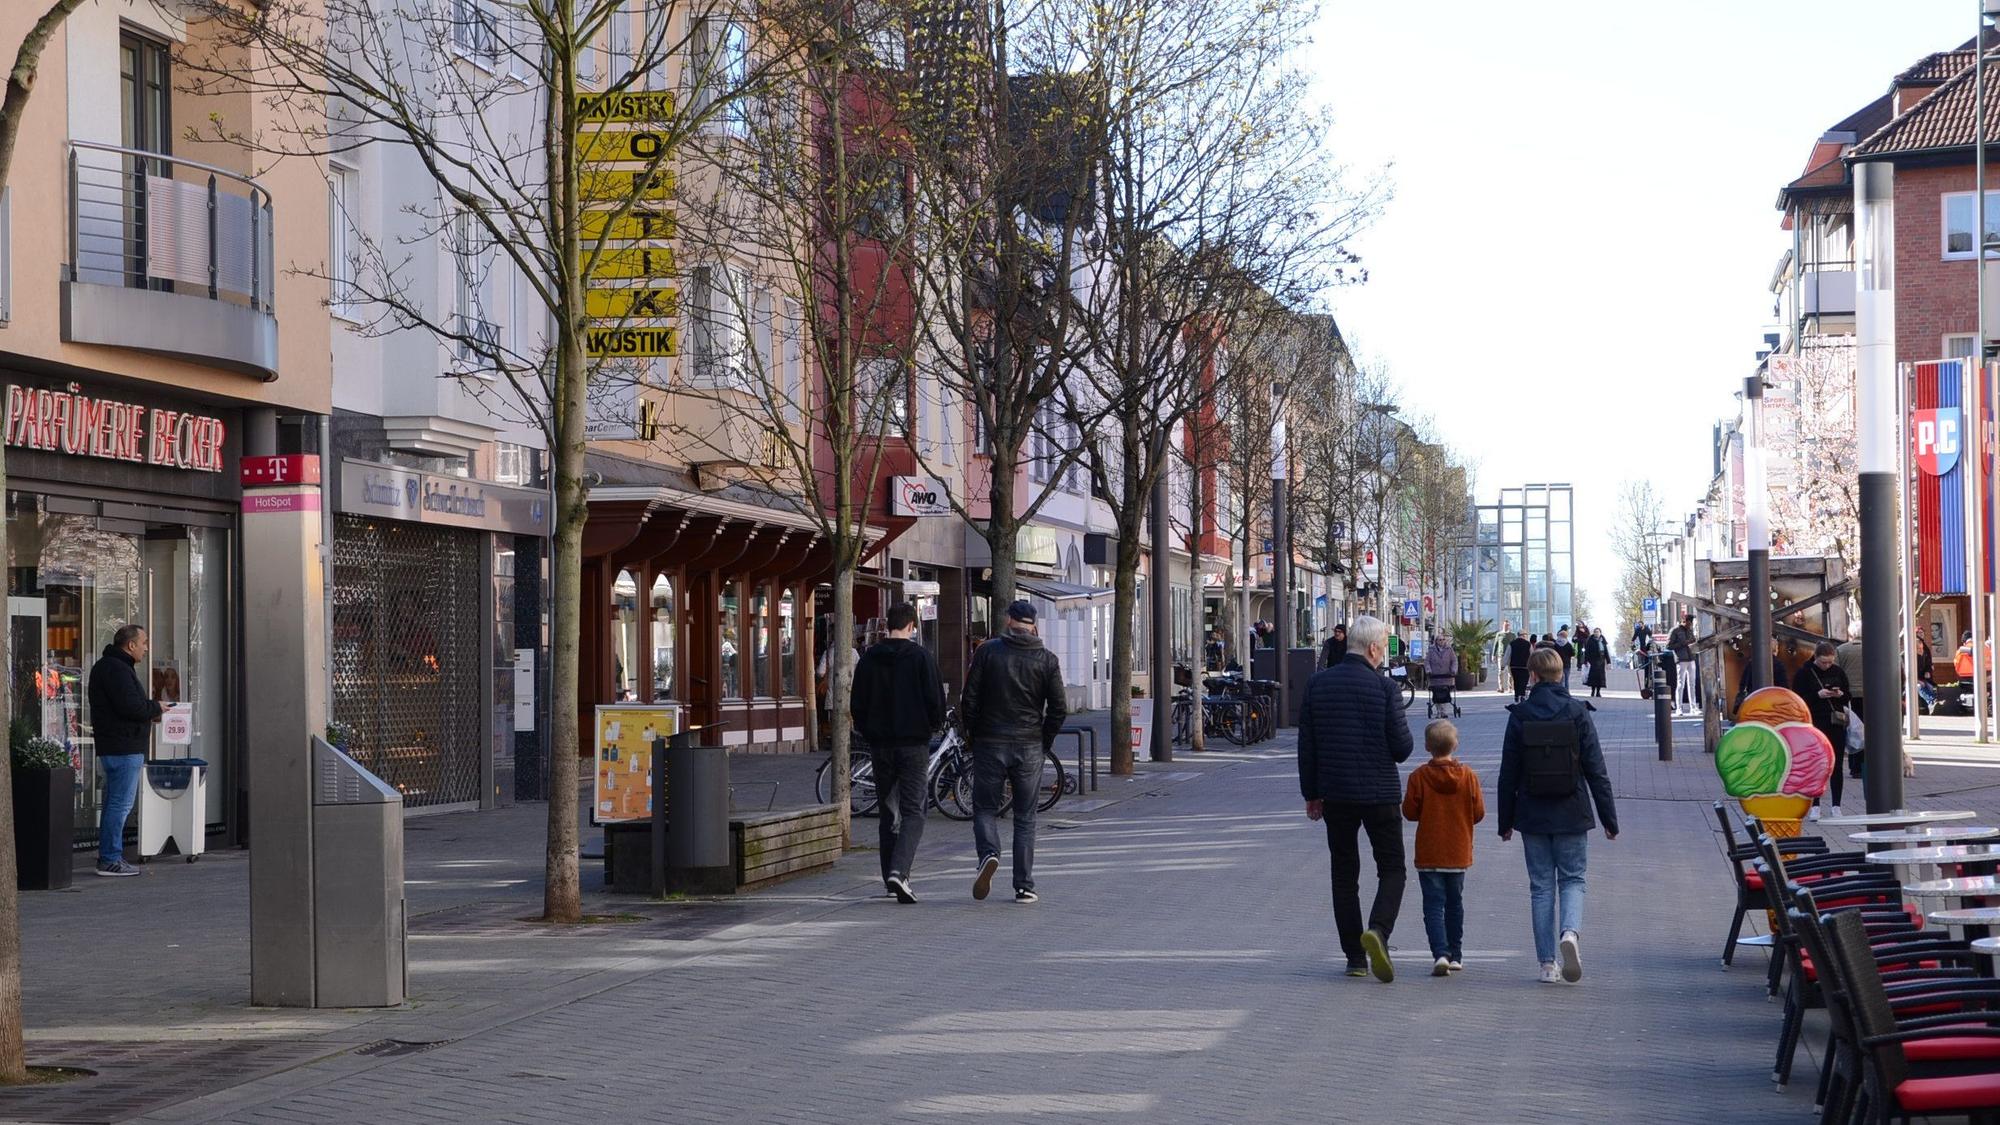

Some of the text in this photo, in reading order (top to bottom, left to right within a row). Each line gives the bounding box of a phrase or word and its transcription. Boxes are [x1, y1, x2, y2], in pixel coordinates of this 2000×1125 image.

[577, 96, 668, 118] AKUSTIK
[6, 382, 225, 472] PARFÜMERIE BECKER
[255, 496, 291, 508] HotSpot
[911, 491, 936, 505] AWO
[1645, 600, 1653, 610] P
[168, 726, 185, 734] 29.99
